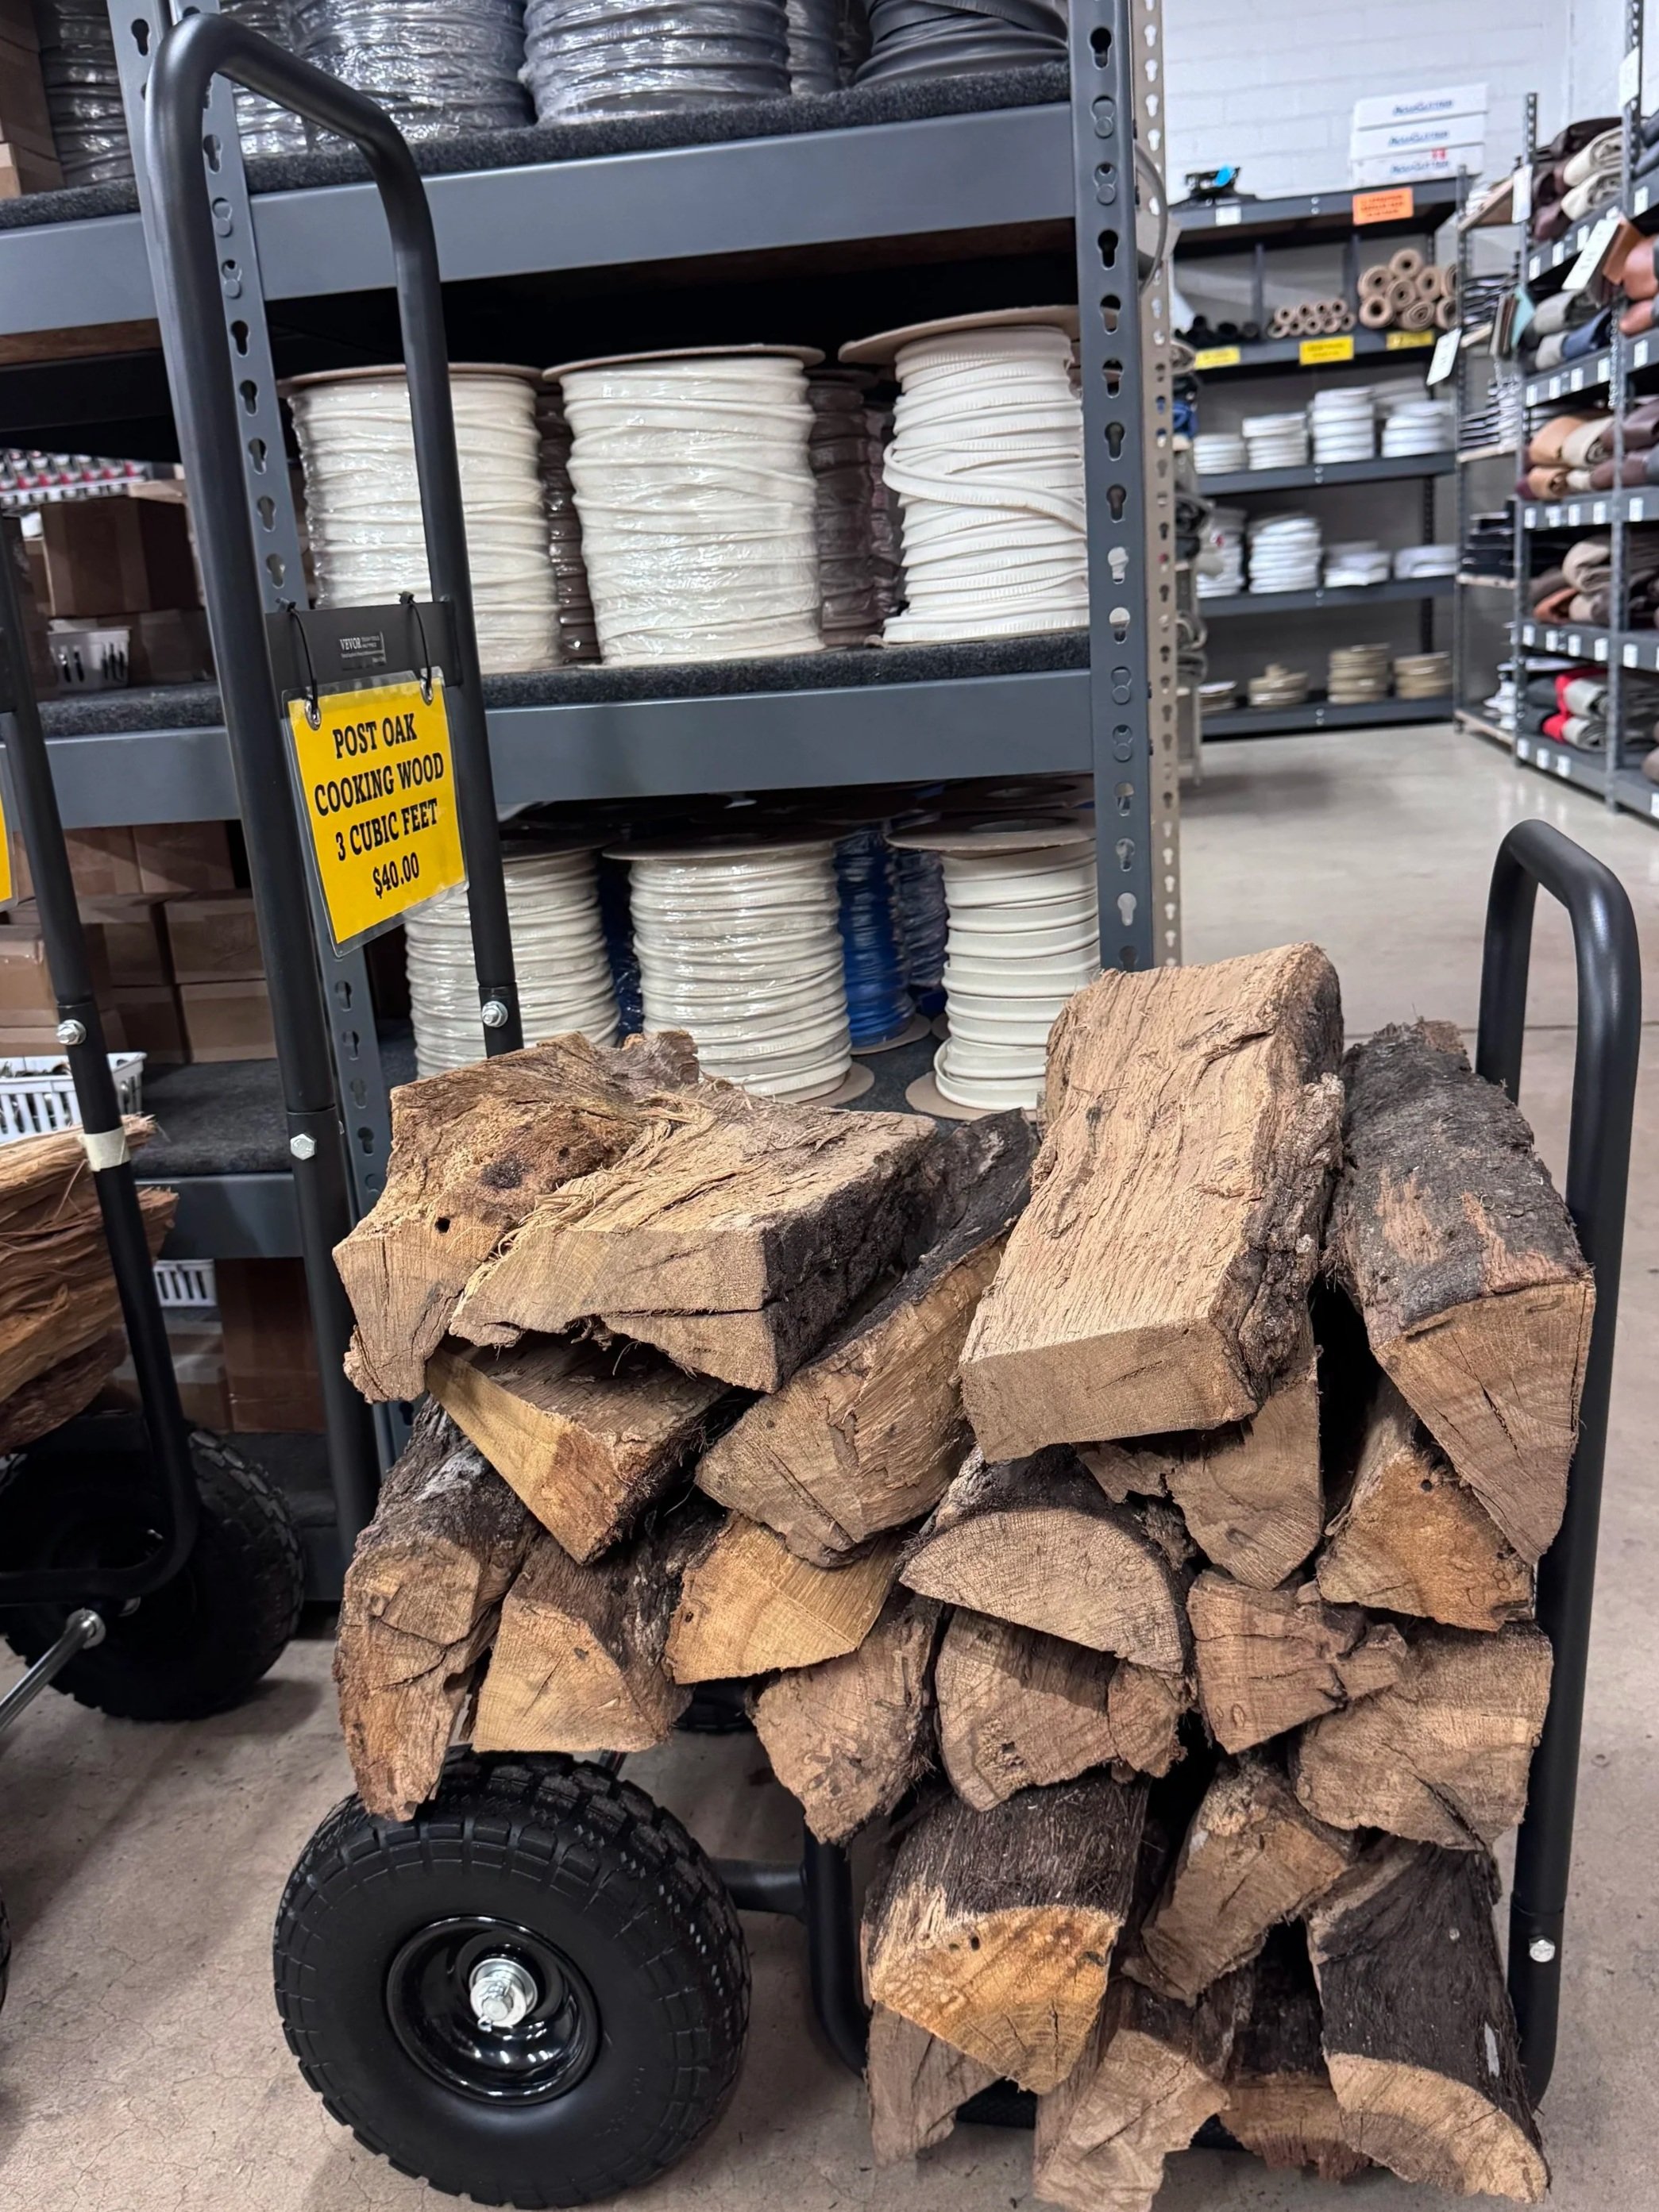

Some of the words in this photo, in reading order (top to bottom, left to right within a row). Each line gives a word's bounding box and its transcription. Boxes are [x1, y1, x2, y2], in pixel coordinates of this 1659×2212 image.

[338, 637, 362, 650] VEVOR
[333, 722, 377, 759] POST
[382, 713, 417, 747] OAK
[314, 765, 394, 816] COOKING
[397, 752, 444, 789] WOOD
[336, 831, 346, 861] 3
[349, 811, 399, 855] CUBIC
[401, 798, 438, 835] FEET
[372, 852, 419, 899] $40.00
